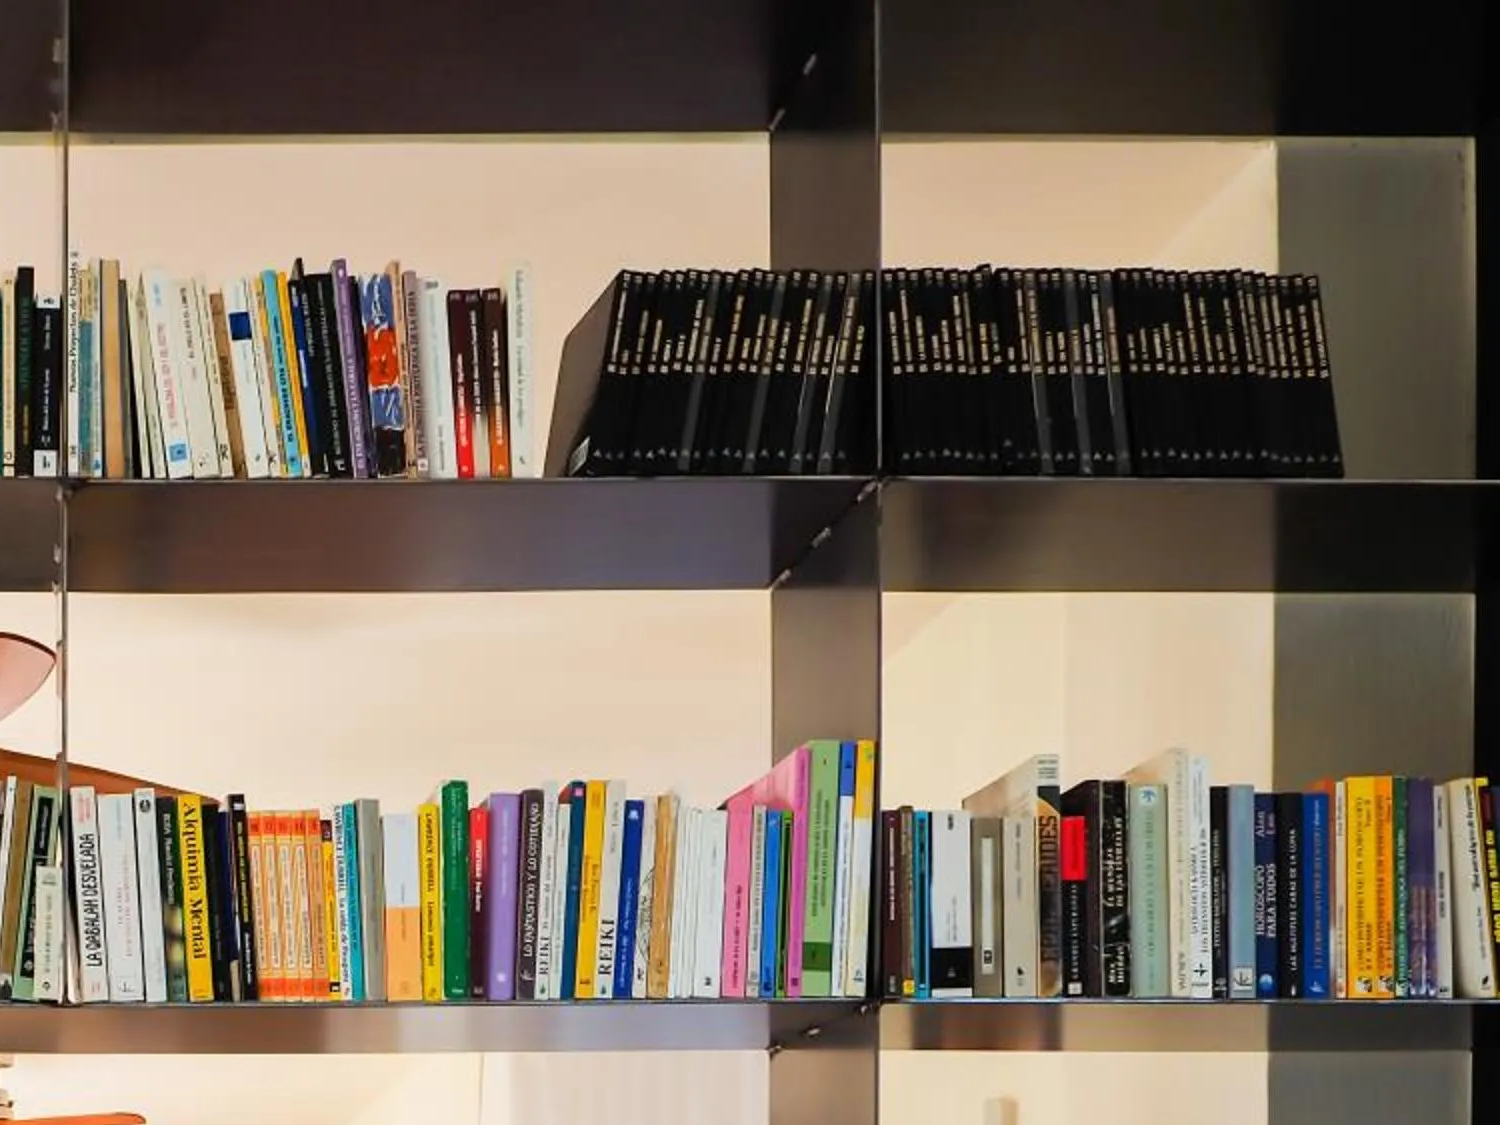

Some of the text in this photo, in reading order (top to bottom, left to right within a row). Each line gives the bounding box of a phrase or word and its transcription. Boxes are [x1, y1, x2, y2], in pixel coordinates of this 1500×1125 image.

[1256, 811, 1266, 837] Alan
[182, 803, 207, 960] Alquimia Mental
[528, 858, 537, 870] LO
[79, 833, 102, 967] LA QABALAH DESVELADA
[524, 884, 537, 943] FANTASTICO
[1266, 863, 1277, 937] PARA TODOS
[524, 945, 534, 957] LO
[538, 935, 550, 975] REIKI
[598, 919, 615, 975] REIKI
